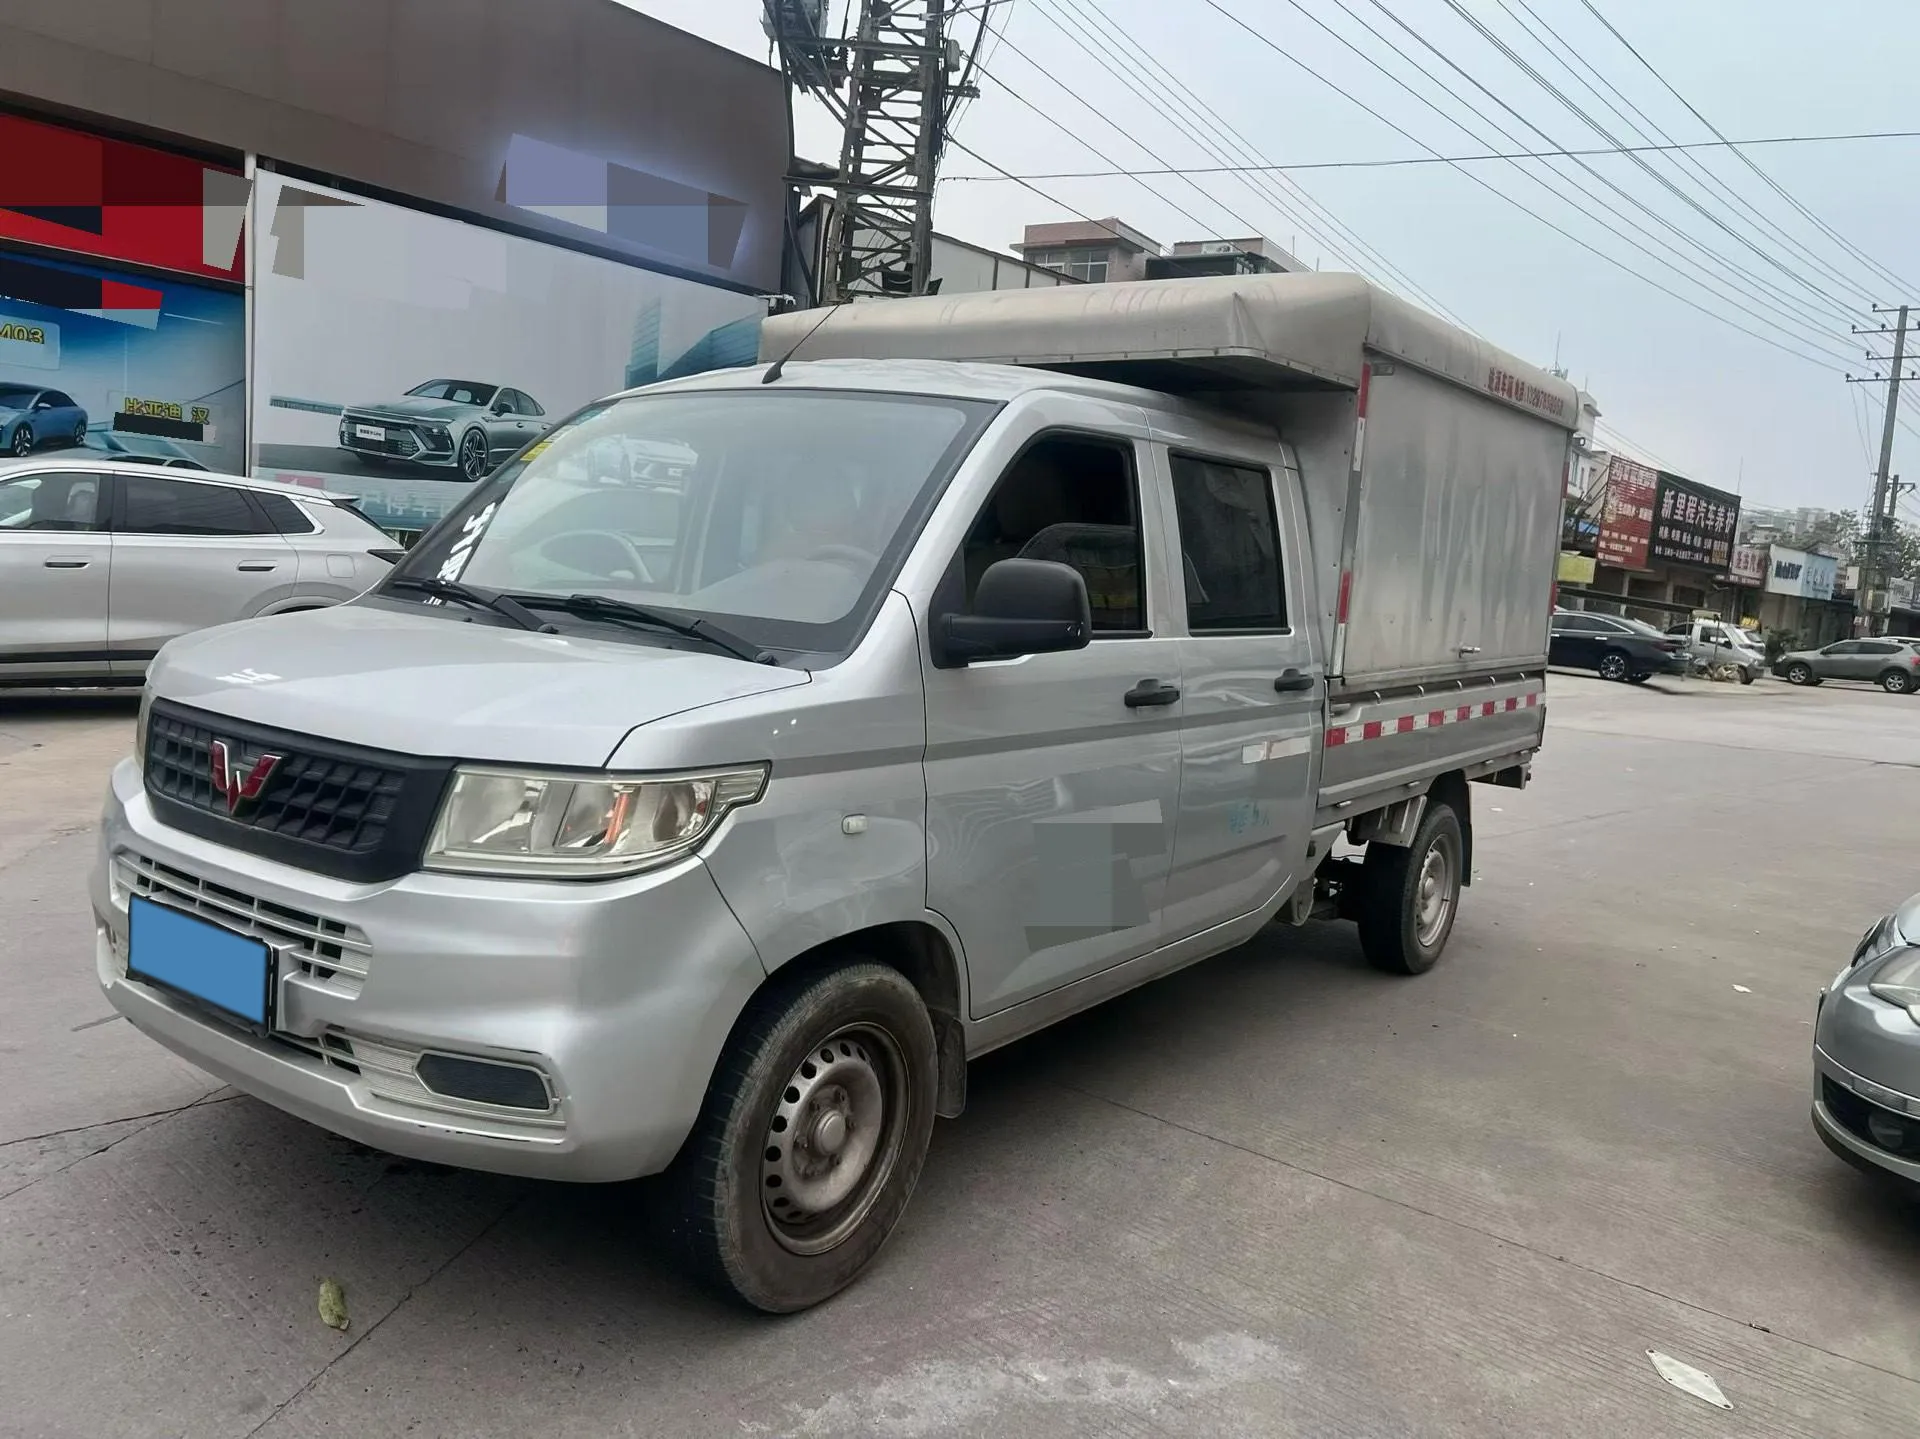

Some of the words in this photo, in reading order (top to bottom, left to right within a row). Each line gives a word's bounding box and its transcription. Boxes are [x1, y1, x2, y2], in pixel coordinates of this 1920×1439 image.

[125, 397, 183, 421] 比亚迪
[191, 407, 210, 425] 汉
[1661, 488, 1736, 533] 新里程汽车养护
